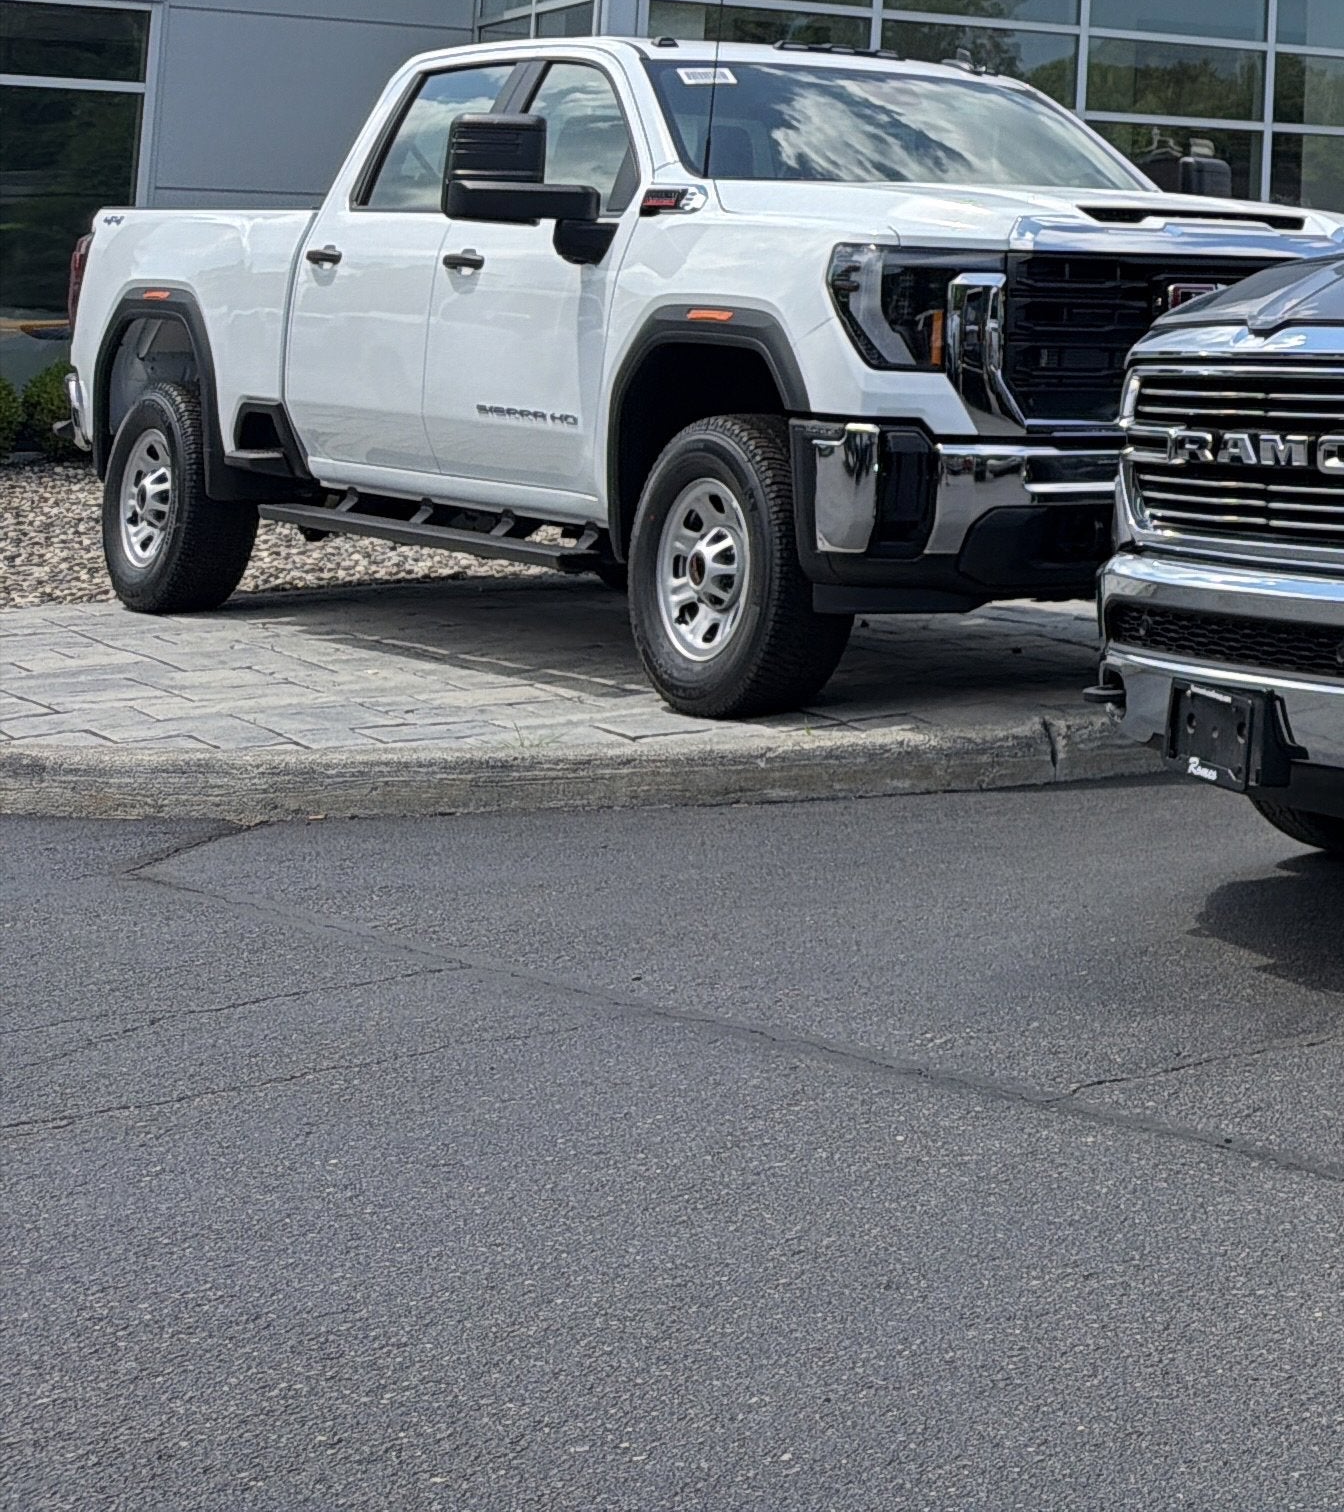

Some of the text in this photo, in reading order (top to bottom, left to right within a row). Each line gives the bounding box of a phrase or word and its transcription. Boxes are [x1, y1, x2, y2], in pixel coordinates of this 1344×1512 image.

[476, 404, 578, 426] SIERRA HD
[1170, 430, 1309, 467] RAM
